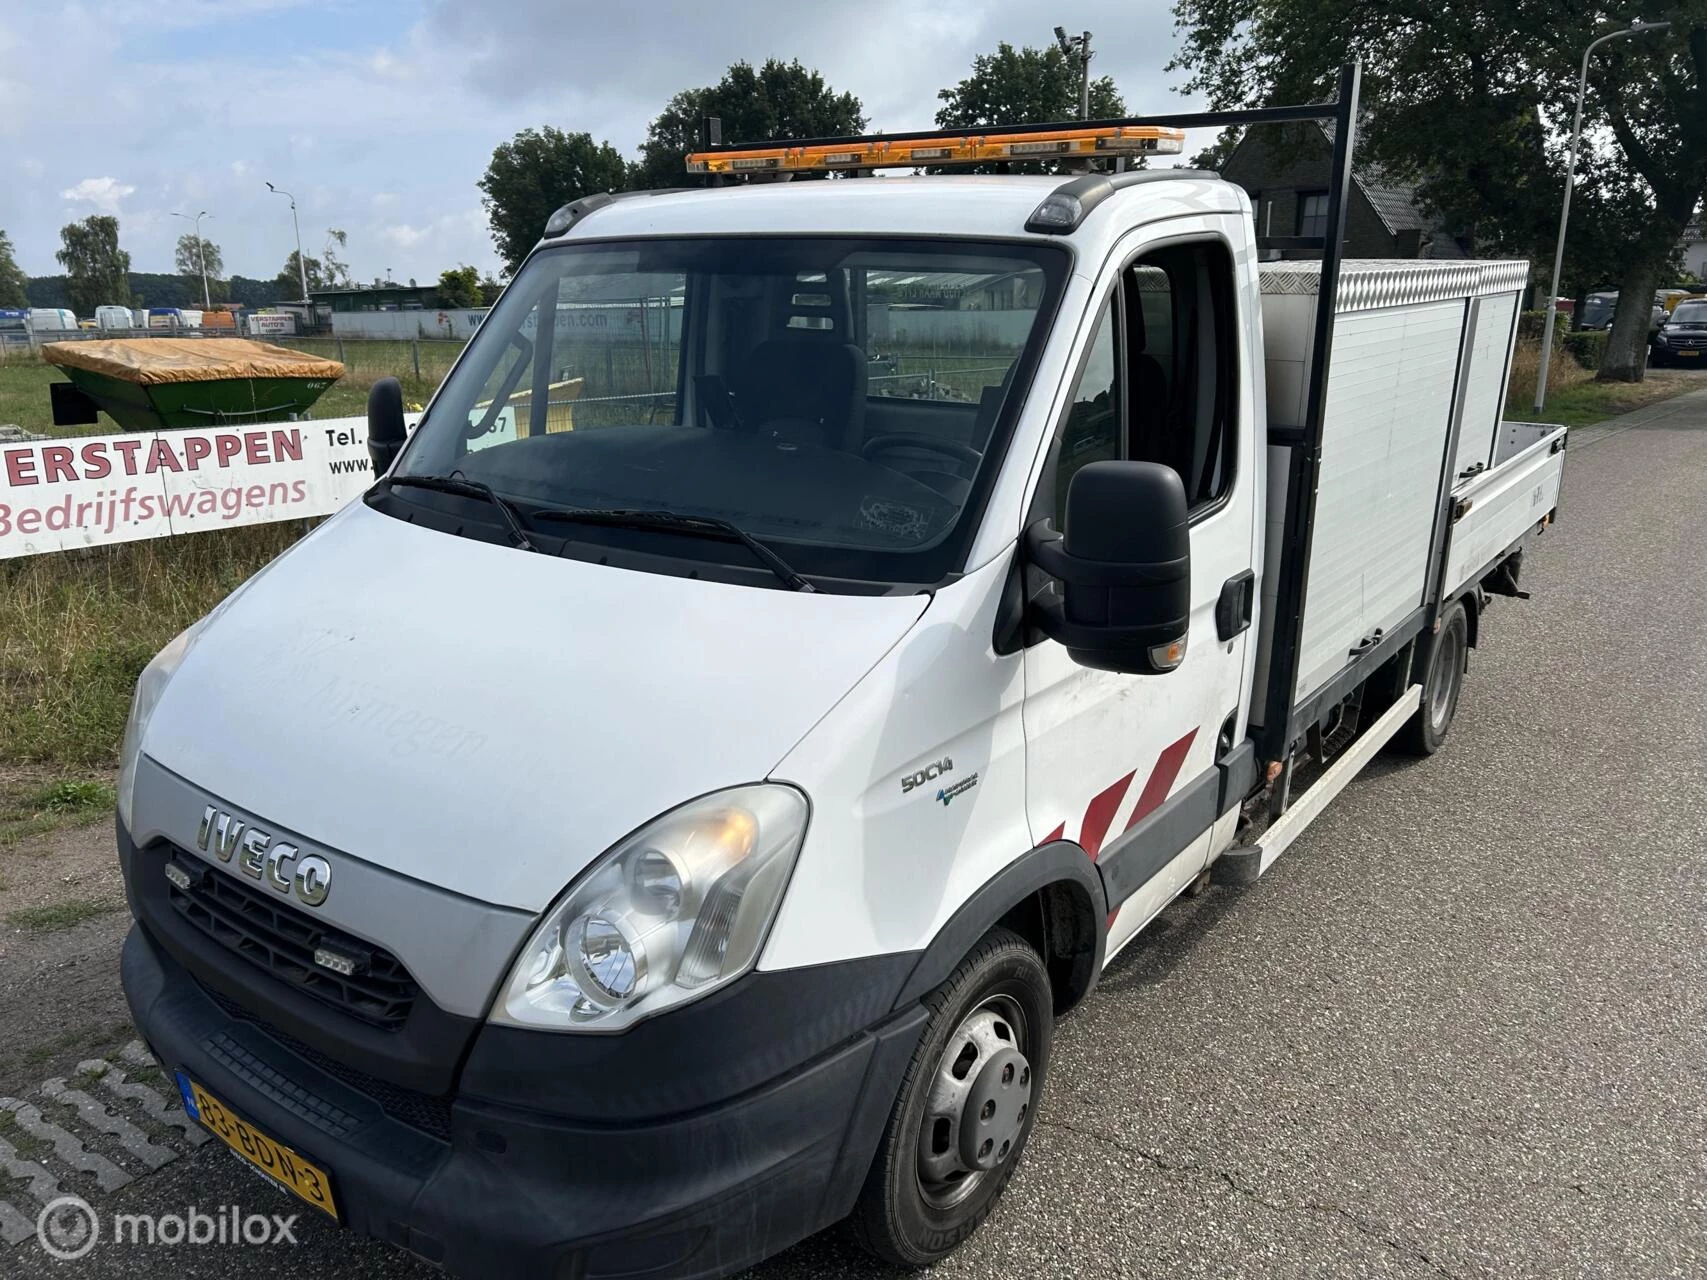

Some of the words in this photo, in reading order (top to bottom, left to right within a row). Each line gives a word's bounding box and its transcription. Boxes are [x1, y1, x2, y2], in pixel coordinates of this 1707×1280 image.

[325, 428, 363, 447] Tel.
[0, 480, 306, 536] Bedrijfswagens
[901, 756, 953, 794] 50C14
[197, 804, 332, 907] IVECO
[198, 1093, 325, 1202] 83-BDN-3
